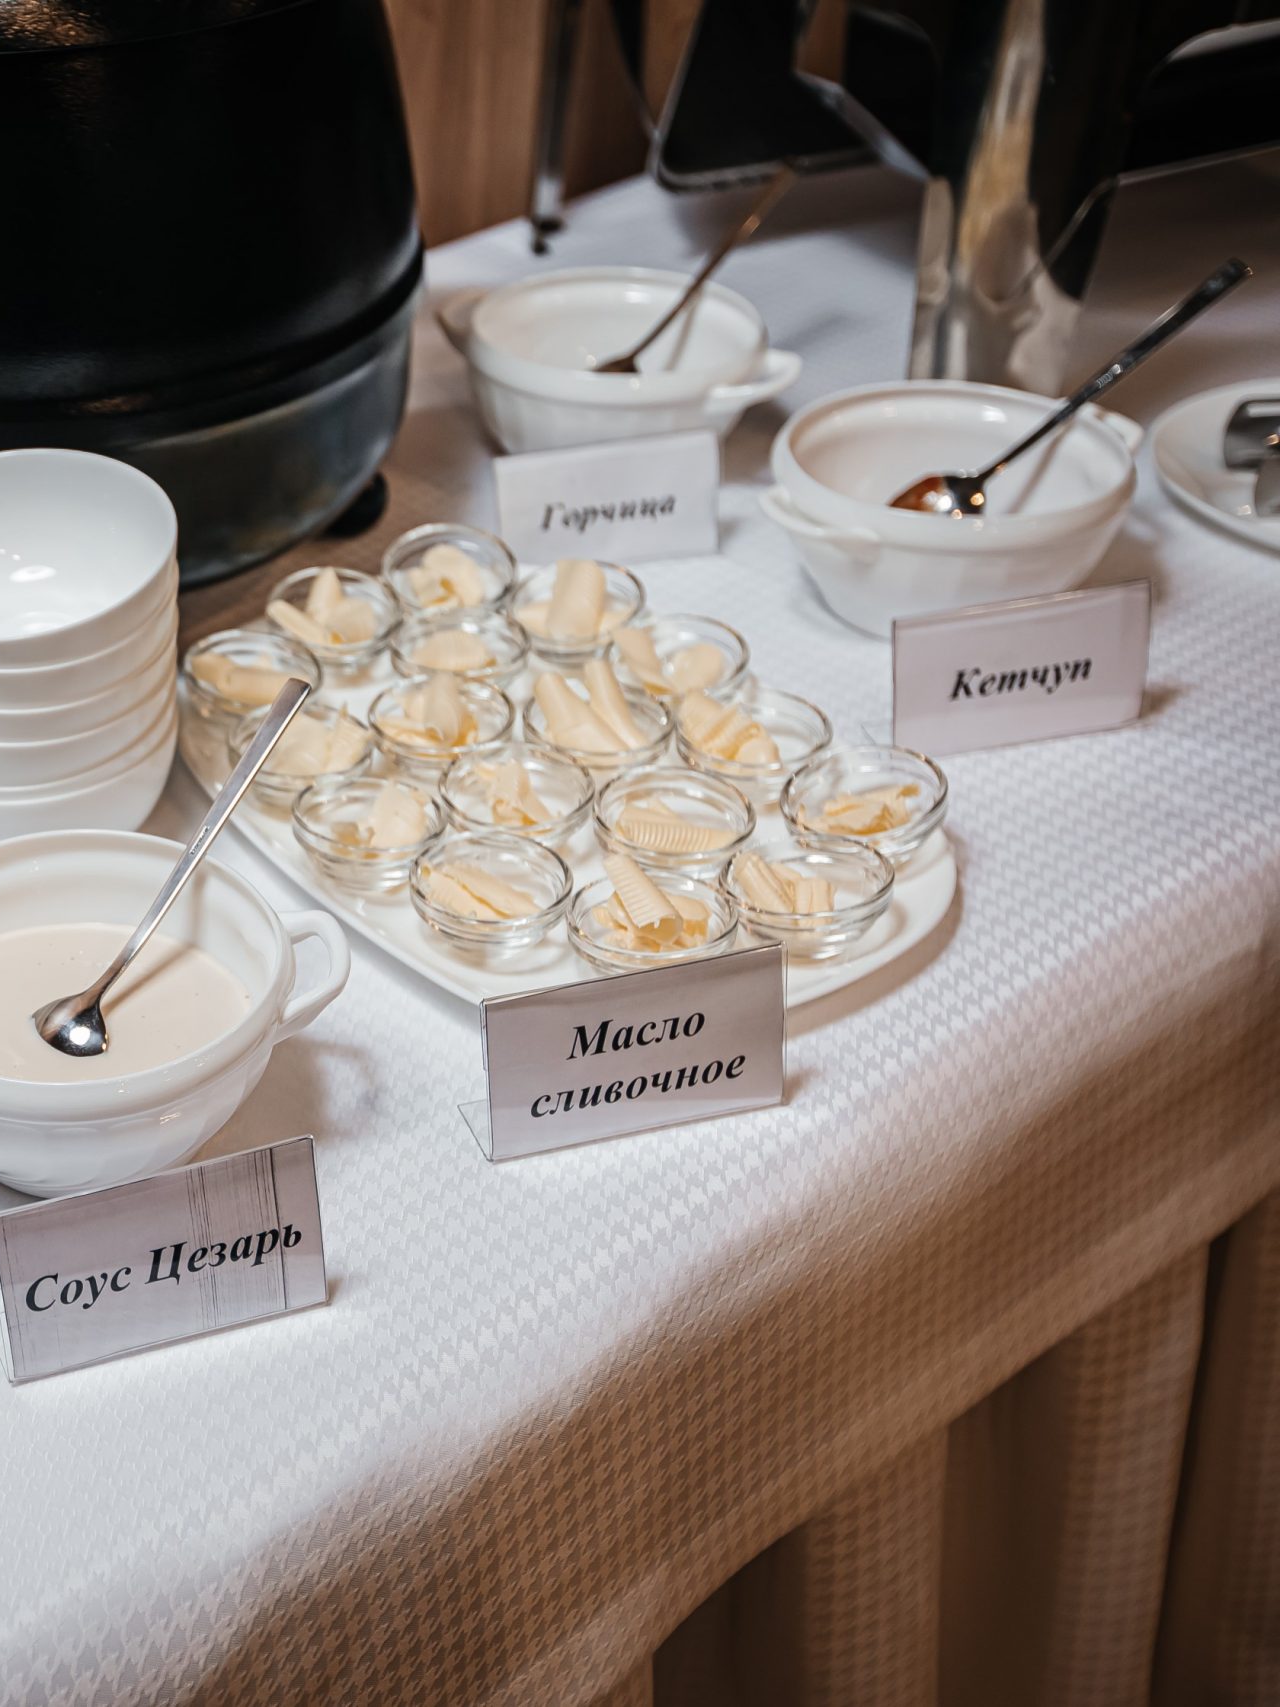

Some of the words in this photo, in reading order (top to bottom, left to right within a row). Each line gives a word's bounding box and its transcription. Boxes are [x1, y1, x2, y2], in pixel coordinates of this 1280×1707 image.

[541, 495, 676, 533] Горчица
[948, 658, 1093, 702] Кетчуп
[566, 1012, 706, 1061] Масло
[530, 1054, 747, 1119] сливочное
[25, 1266, 132, 1312] Соус
[144, 1224, 302, 1286] Цезарь
